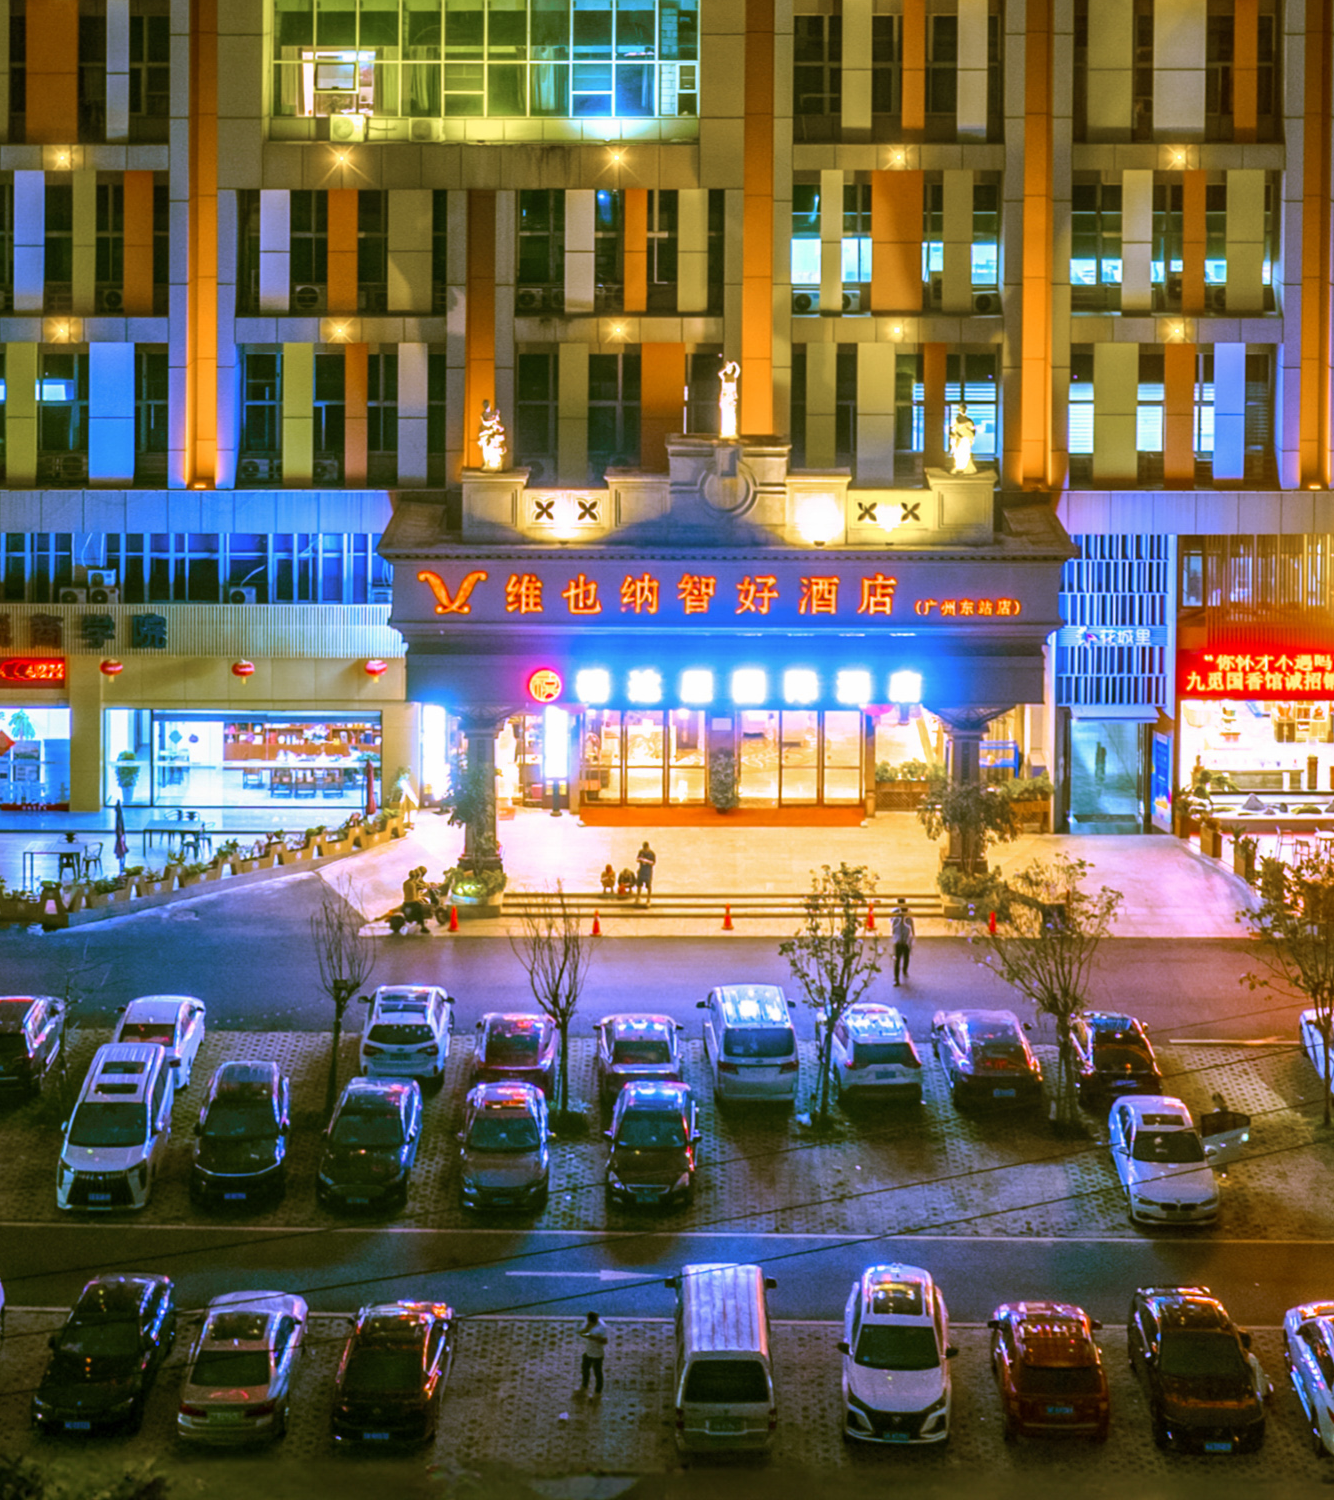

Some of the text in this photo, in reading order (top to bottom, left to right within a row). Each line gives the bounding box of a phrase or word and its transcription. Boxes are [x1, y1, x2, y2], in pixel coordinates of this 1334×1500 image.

[504, 572, 898, 615] 维也纳智好酒店
[1099, 628, 1152, 646] 花城里
